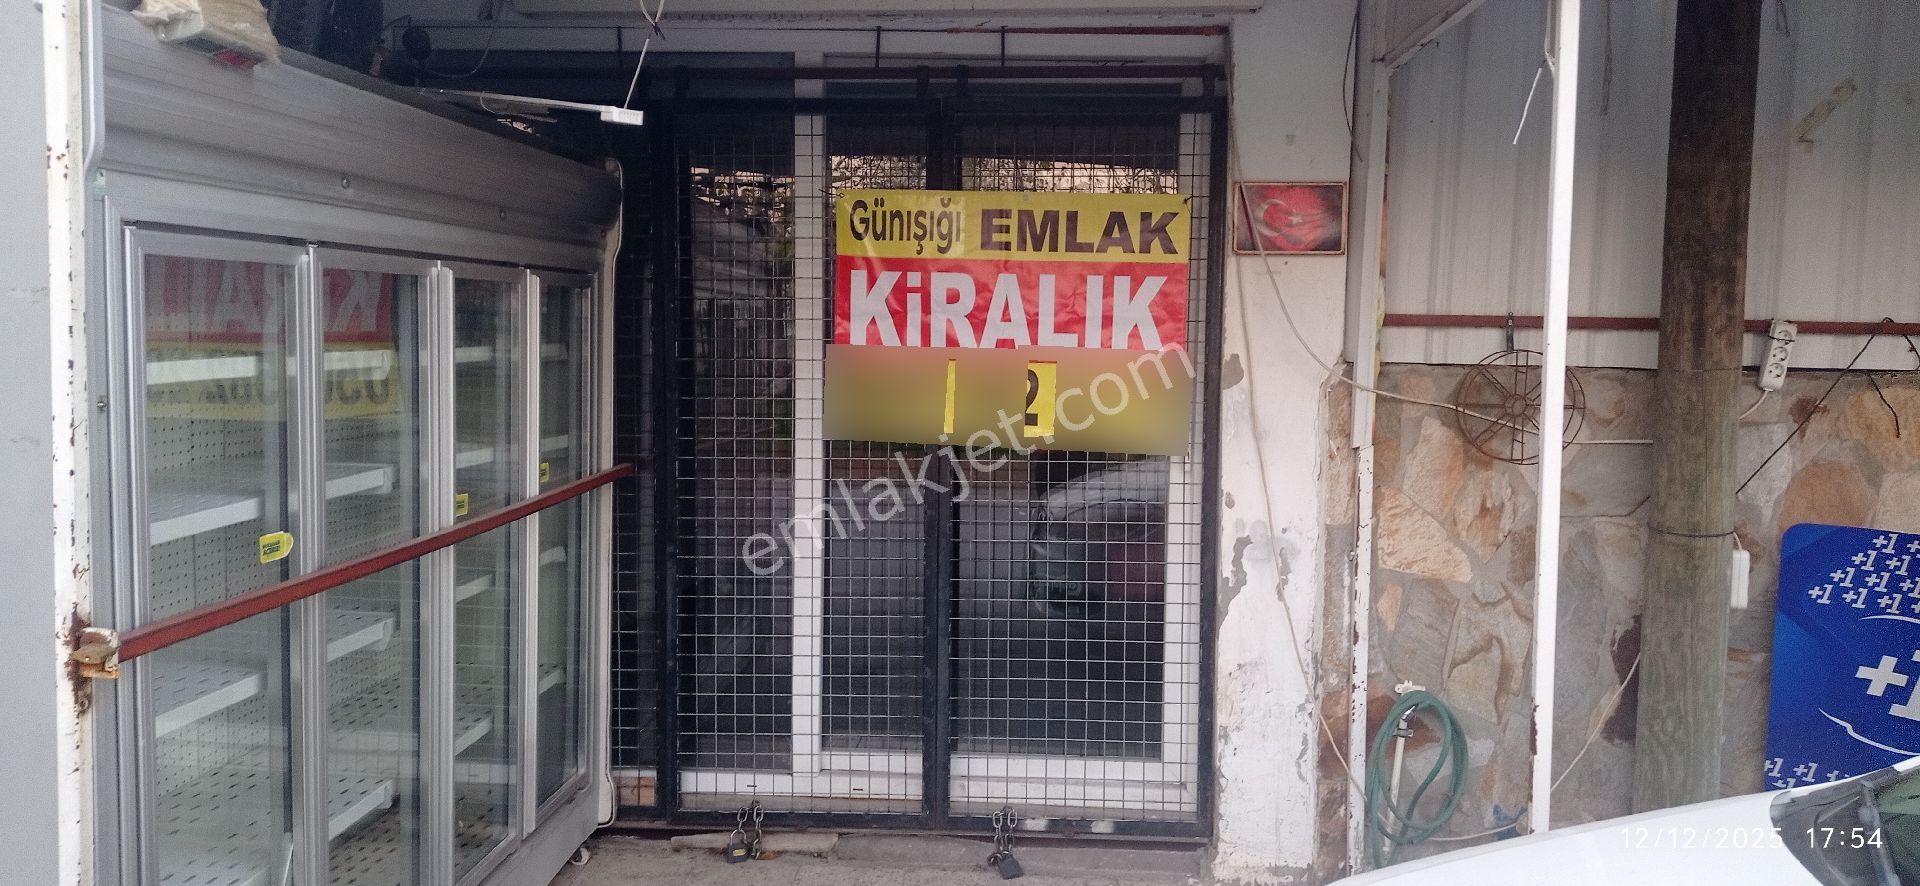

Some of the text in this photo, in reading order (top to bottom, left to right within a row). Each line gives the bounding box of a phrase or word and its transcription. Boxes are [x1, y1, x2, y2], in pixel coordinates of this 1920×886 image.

[980, 208, 1179, 254] EMLAK
[1872, 533, 1899, 554] +1
[1851, 550, 1911, 576] +1 +1
[1829, 567, 1855, 588] +1
[1865, 572, 1891, 592] +1
[1808, 584, 1833, 605] +1
[1842, 587, 1868, 609] +1
[1877, 593, 1903, 614] +1
